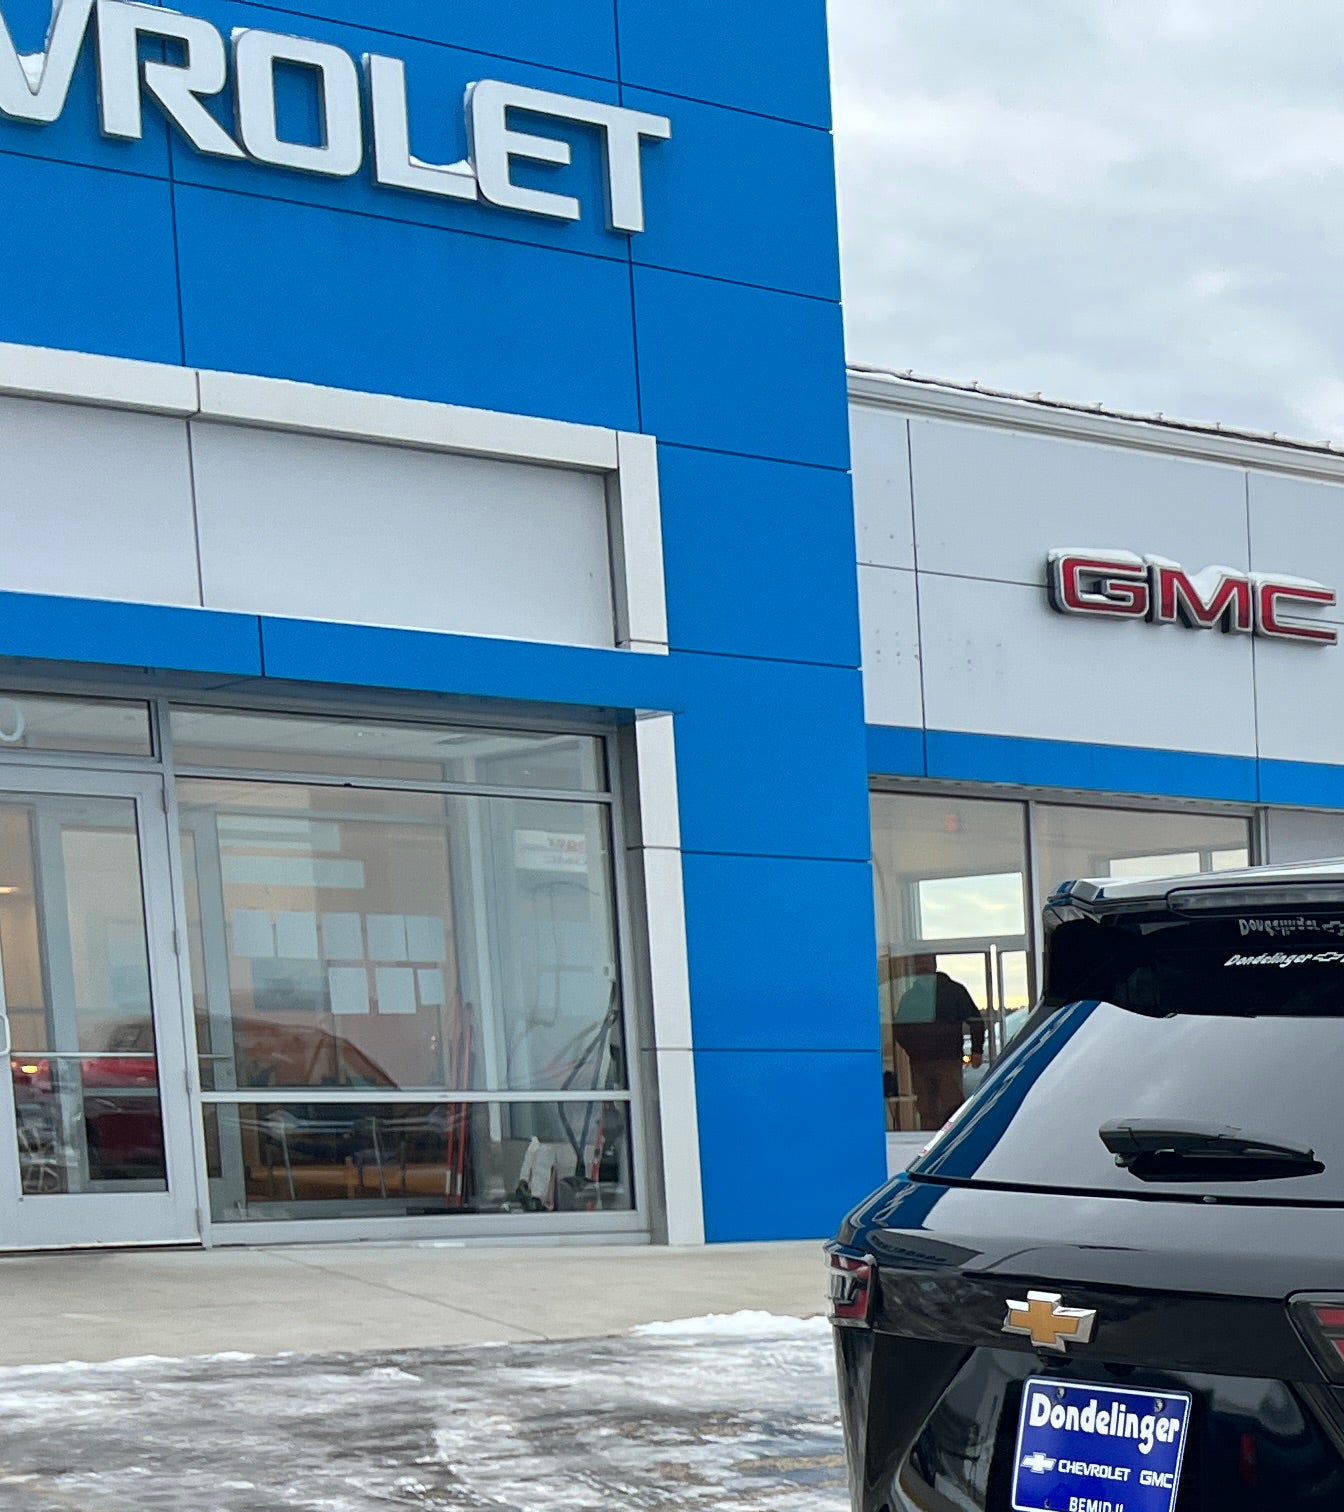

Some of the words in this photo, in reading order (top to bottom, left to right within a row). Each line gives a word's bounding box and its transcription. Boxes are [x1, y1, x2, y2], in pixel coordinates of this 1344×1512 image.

[1049, 552, 1338, 646] GMC
[1224, 952, 1313, 968] Dondelinger
[1029, 1392, 1180, 1455] Dondelinger
[1057, 1461, 1131, 1482] CHEVROLET
[1139, 1470, 1174, 1489] GMC
